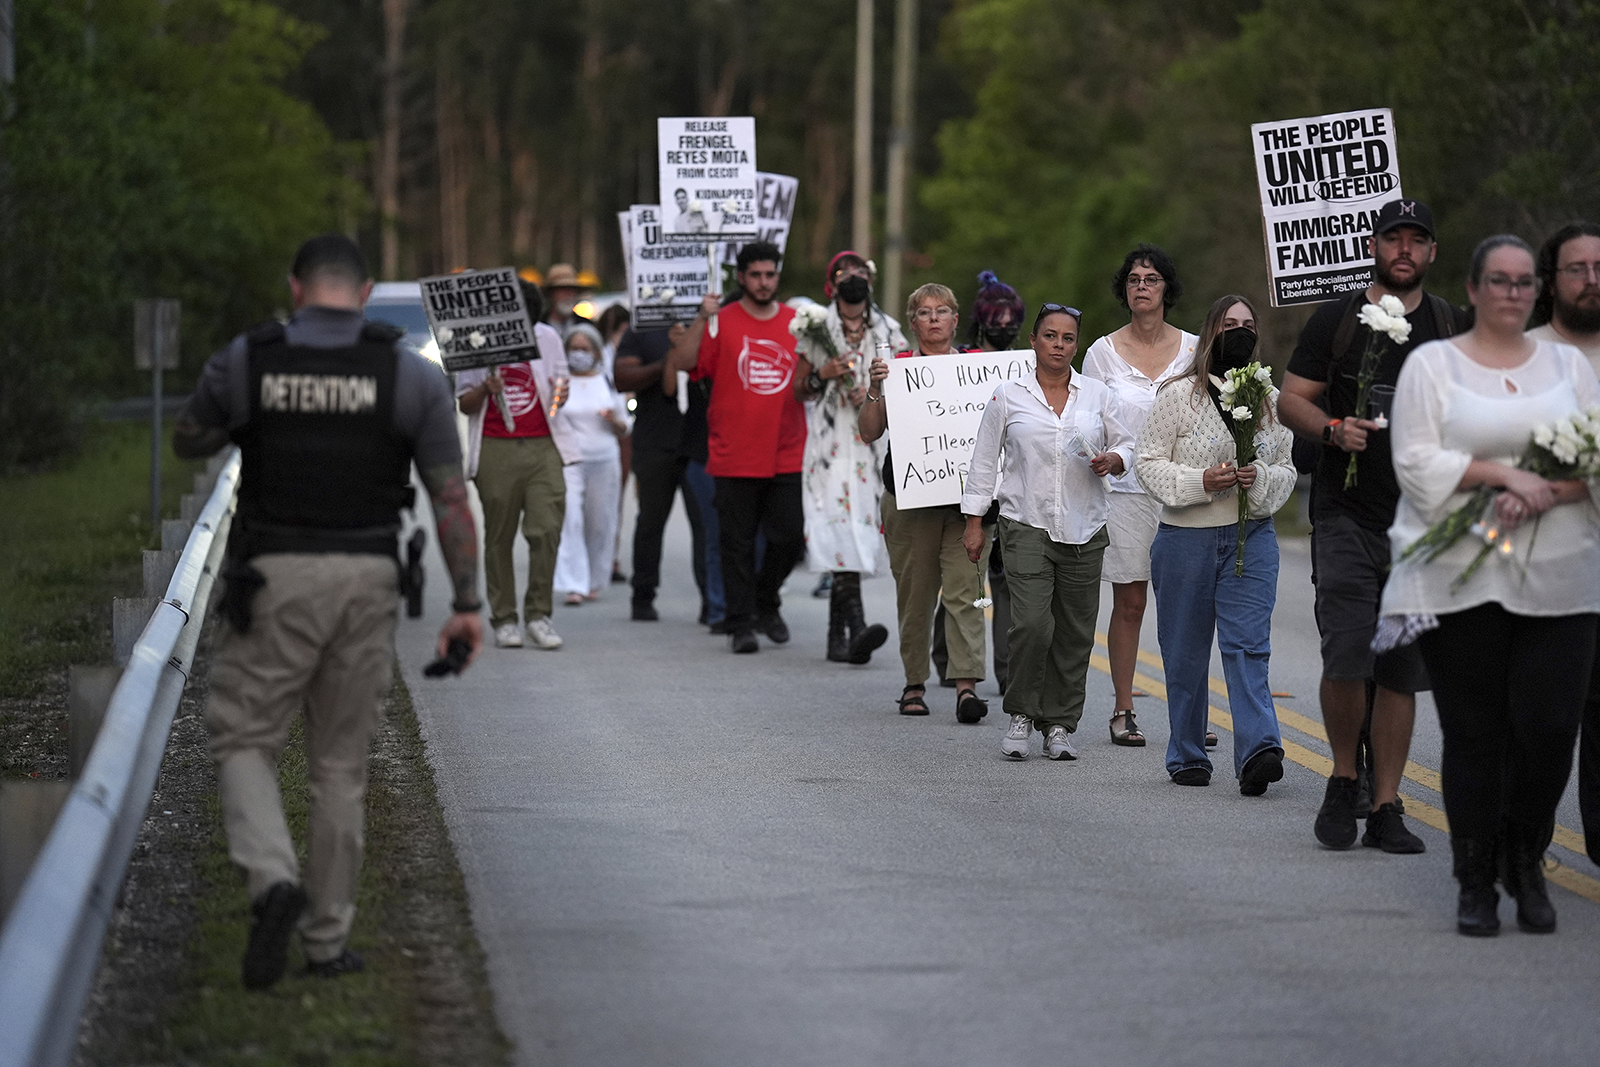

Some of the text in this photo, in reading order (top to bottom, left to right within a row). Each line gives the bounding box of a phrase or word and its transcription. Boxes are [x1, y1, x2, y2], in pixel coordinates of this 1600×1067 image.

[685, 121, 728, 132] RELEASE
[1259, 115, 1386, 150] THE PEOPLE
[679, 135, 735, 149] FRENGEL
[667, 150, 749, 164] REYES MOTA
[1264, 139, 1389, 187] UNITED
[677, 167, 739, 179] FROM CECOT
[695, 189, 753, 199] KIDNAPPED
[1268, 173, 1393, 207] WILL DEFEND
[1273, 209, 1381, 243] IMMIGRAN
[1276, 235, 1374, 270] FAMILIE
[425, 271, 513, 293] THE PEOPLE
[1281, 271, 1371, 290] Party for Socialism and
[1282, 281, 1374, 299] Liberation PSLWeb.o
[430, 285, 516, 311] UNITED
[434, 302, 520, 321] WILL DEFEND
[904, 366, 935, 393] NO
[261, 373, 377, 413] DETENTION
[903, 459, 970, 490] Abolis
